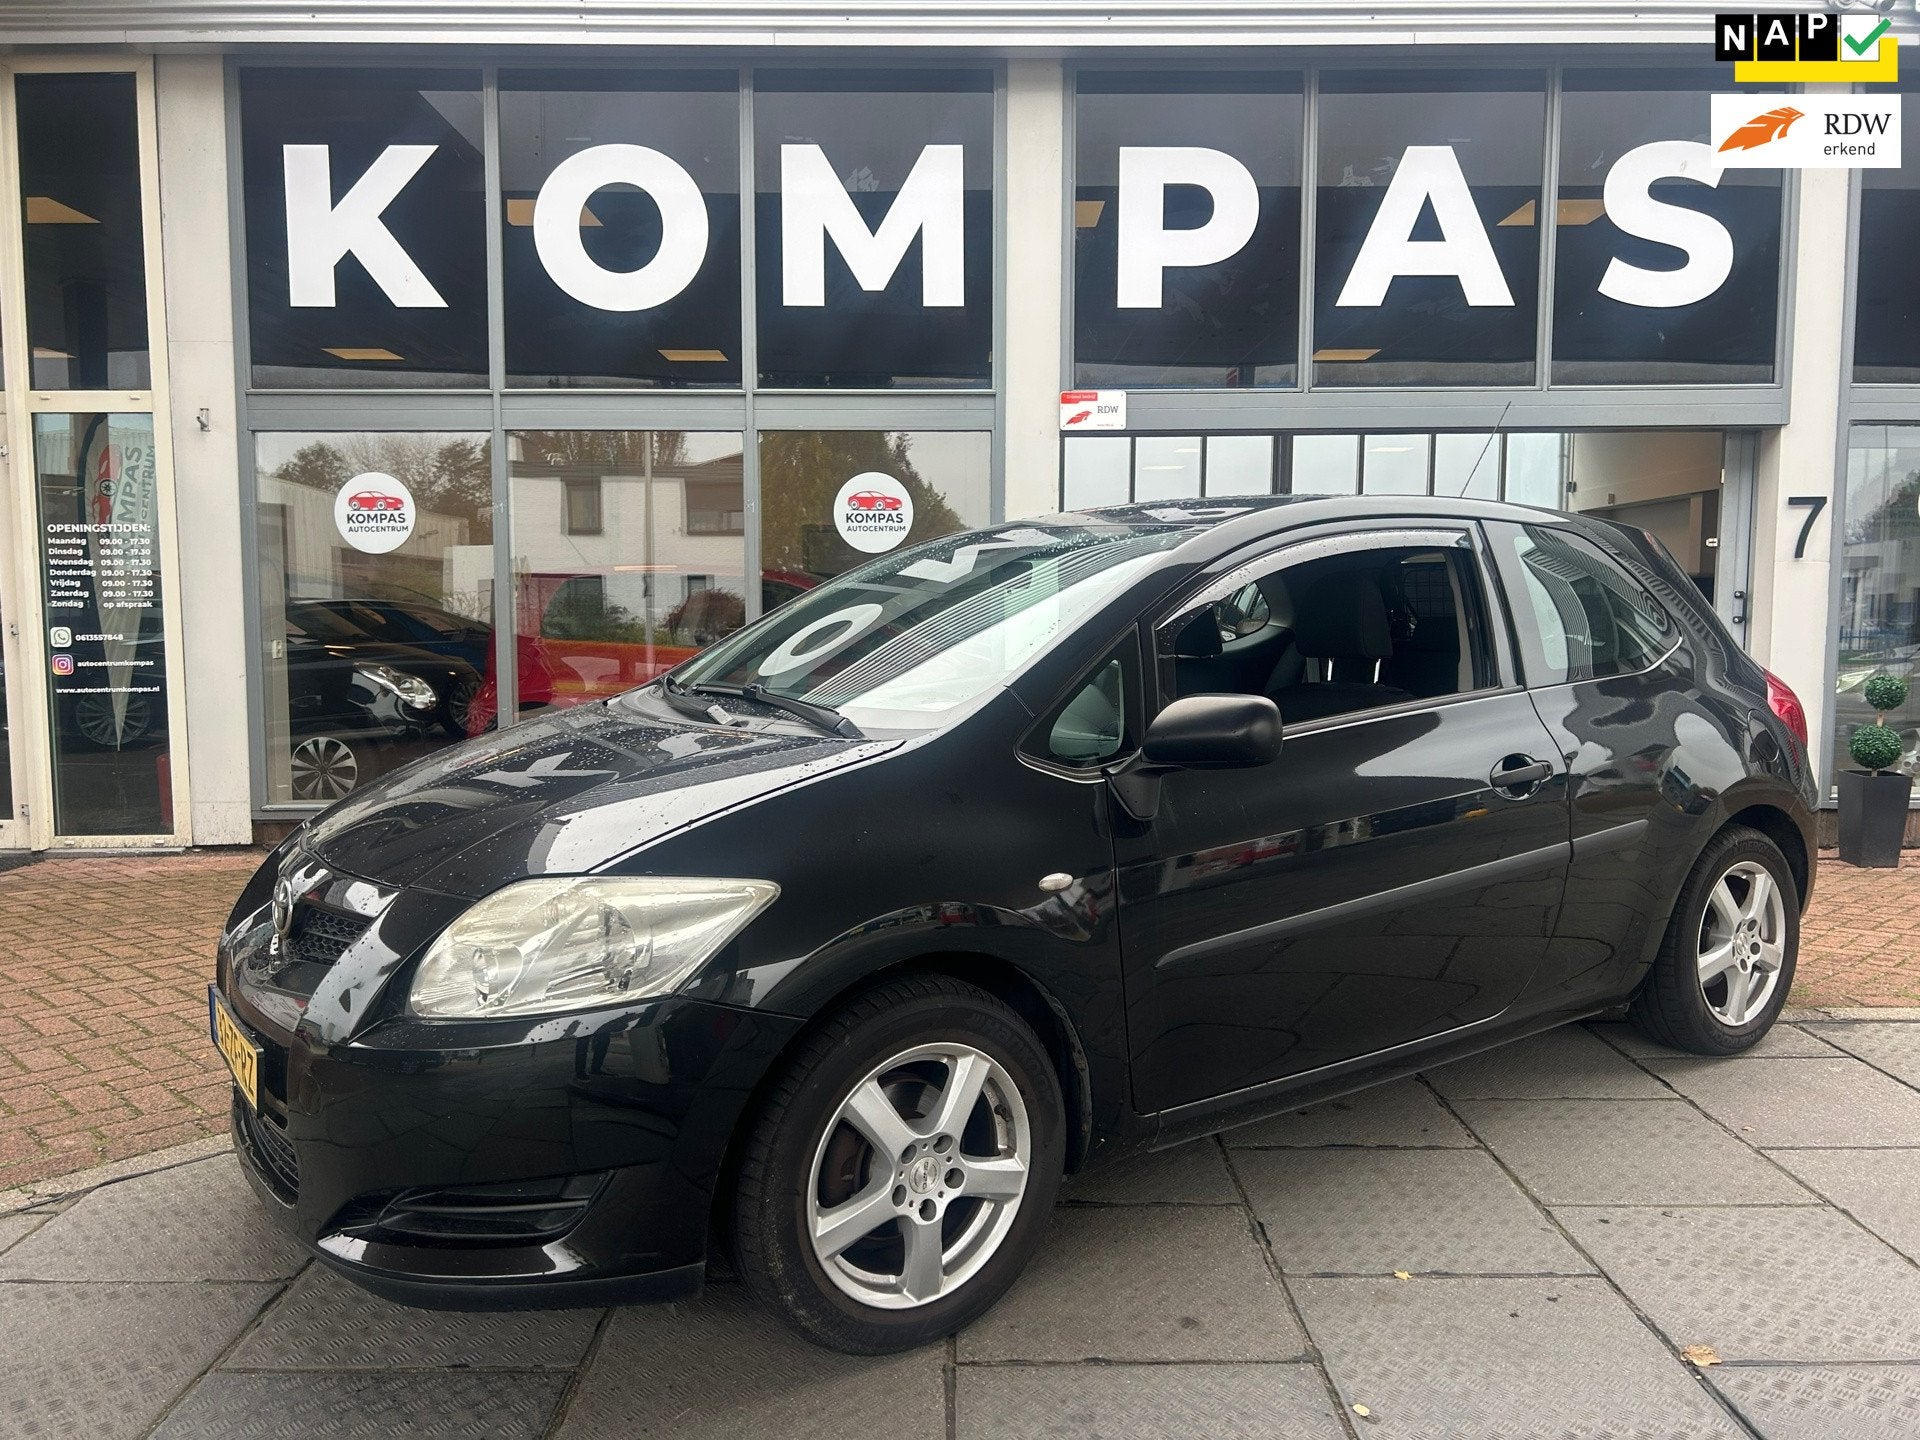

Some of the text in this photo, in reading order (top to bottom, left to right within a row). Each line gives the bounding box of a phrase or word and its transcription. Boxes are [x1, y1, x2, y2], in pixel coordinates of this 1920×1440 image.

[282, 143, 1735, 312] KOMPAS
[347, 513, 405, 524] KOMPAS
[846, 513, 903, 523] KOMPAS
[47, 523, 151, 533] OPENINGSTIJDEN:
[1787, 495, 1828, 559] 7
[48, 537, 87, 546] Maandag
[48, 547, 83, 556] Dinsdag
[131, 548, 152, 556] 17.30
[49, 558, 94, 567] Woensdag
[49, 568, 96, 577] Donderdag
[50, 579, 81, 588] Vrijdag
[50, 589, 89, 598] Zaterdag
[51, 600, 153, 609] Zondag op afspraak
[56, 686, 160, 694] www.autocentrumkompas.nl
